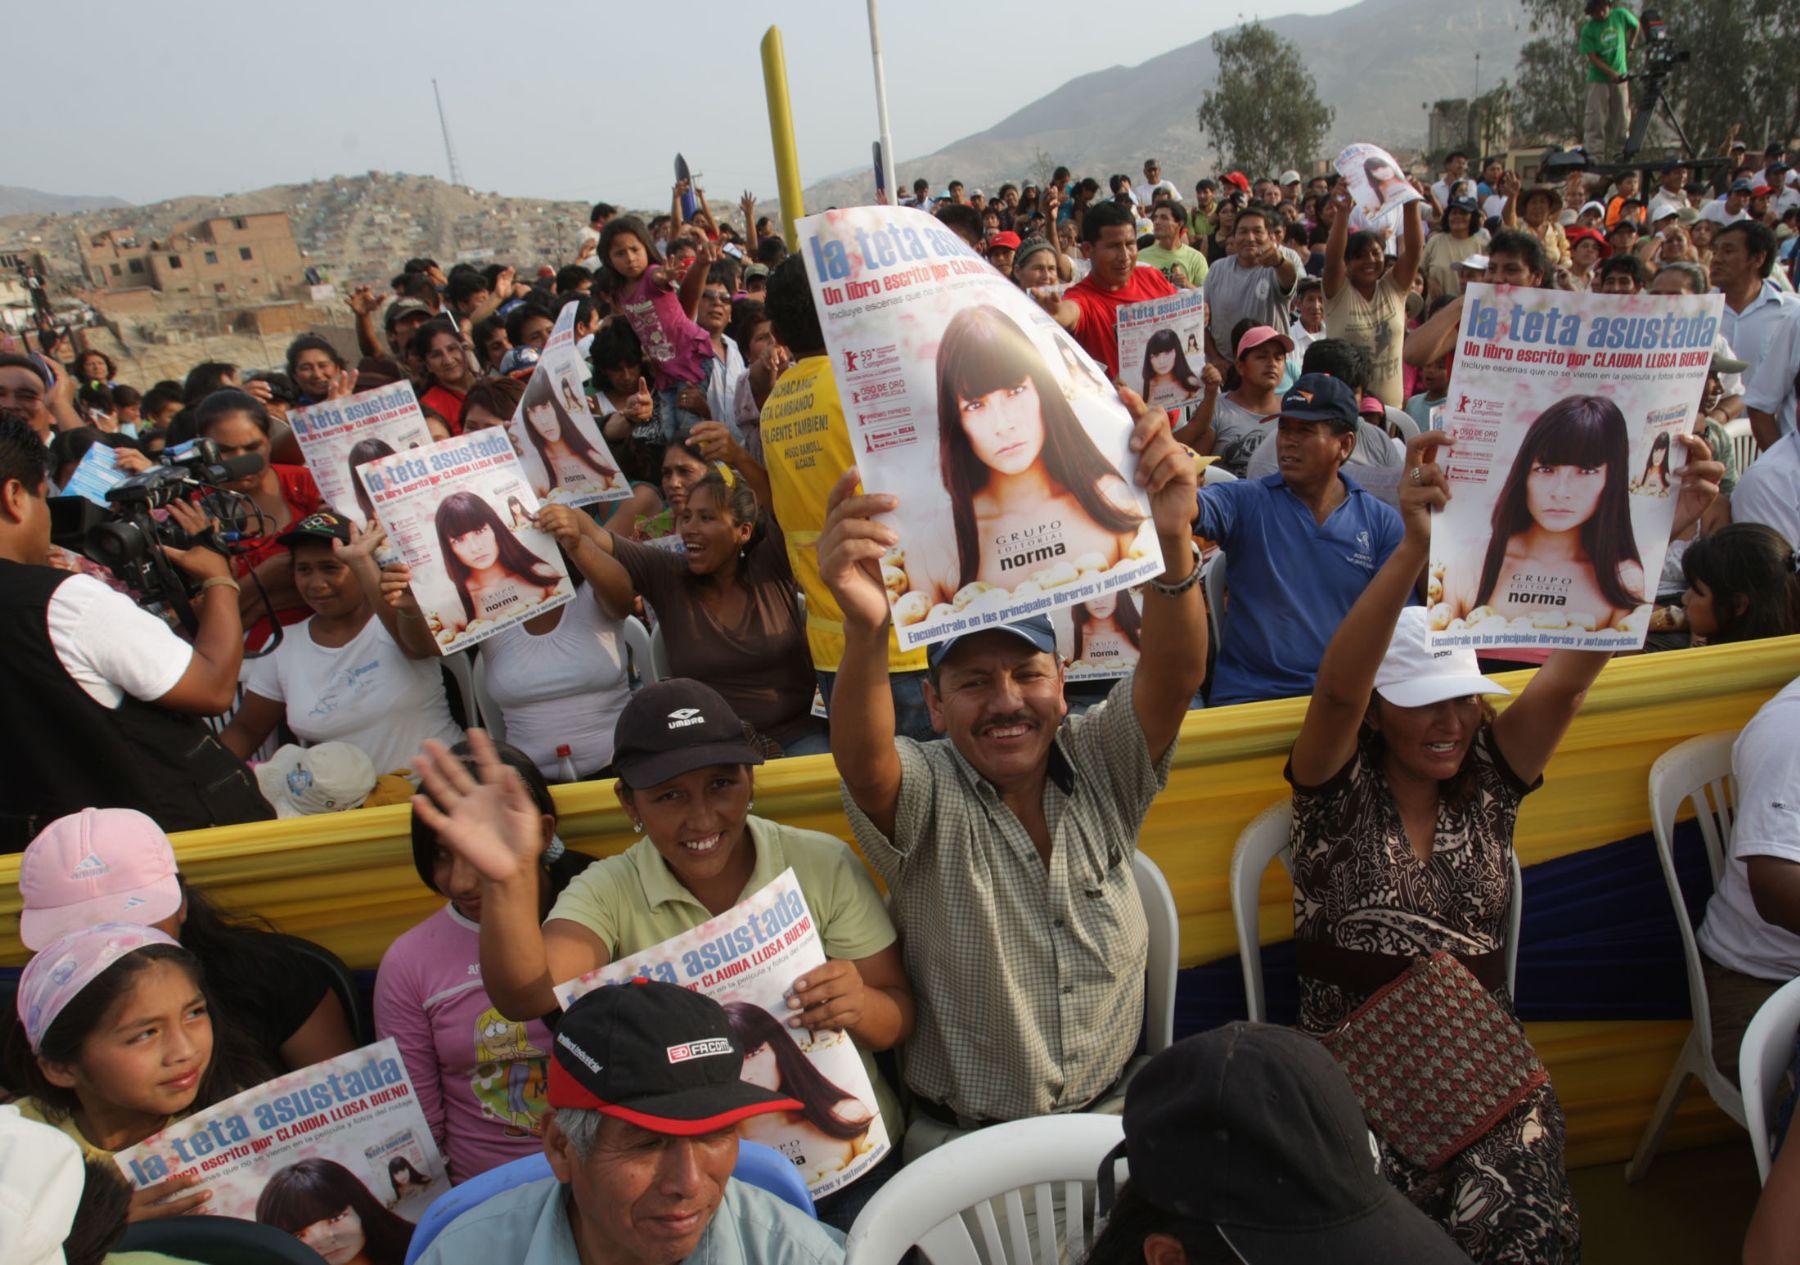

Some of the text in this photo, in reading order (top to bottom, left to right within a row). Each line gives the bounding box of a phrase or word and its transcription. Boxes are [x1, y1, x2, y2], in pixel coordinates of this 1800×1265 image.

[809, 235, 849, 282] la
[855, 223, 928, 270] teta
[822, 286, 843, 306] Un
[844, 281, 881, 301] libro
[884, 266, 930, 292] escrito
[828, 306, 863, 322] Incluye
[865, 297, 905, 312] escenas
[906, 292, 922, 302] que
[1158, 293, 1202, 314] asustada
[1467, 299, 1717, 350] la teta asustada
[1464, 341, 1709, 369] Un libro escrito por CLAUDIA LLOSA BUENO
[1461, 360, 1490, 371] Incluye
[1492, 365, 1528, 375] escenas
[1530, 368, 1546, 377] que
[1547, 369, 1559, 377] no
[1560, 370, 1571, 378] se
[1572, 370, 1598, 379] vieron
[1613, 371, 1620, 379] la
[291, 418, 308, 435] la
[309, 409, 343, 430] teta
[345, 390, 414, 421] asustada
[770, 423, 792, 442] GENTE
[364, 470, 385, 493] la
[386, 457, 428, 485] teta
[430, 435, 509, 472] asustada
[442, 465, 473, 480] CLAUDIA
[472, 458, 492, 471] LLOSA
[995, 519, 1063, 547] GRUPO
[997, 532, 1063, 555] EDITORIAL
[1000, 541, 1066, 572] norma
[968, 616, 982, 628] en
[982, 610, 998, 625] las
[999, 597, 1052, 622] principales
[1096, 581, 1103, 593] y
[1104, 559, 1159, 589] autoservicios
[1510, 583, 1570, 592] EDITORIAL
[1512, 574, 1572, 585] GRUPO
[485, 594, 519, 613] norma
[1508, 591, 1567, 606] norma
[1090, 650, 1119, 658] norma
[1472, 635, 1481, 644] en
[1482, 634, 1493, 644] las
[1494, 634, 1537, 646] principales
[1576, 637, 1582, 646] y
[682, 889, 805, 978] asustada
[701, 958, 751, 988] CLAUDIA
[751, 939, 785, 966] LLOSA
[785, 916, 811, 946] BUENO
[728, 980, 736, 989] la
[128, 1057, 402, 1187] la teta asustada
[200, 1083, 409, 1172] escrito por CLAUDIA LLOSA BUENO
